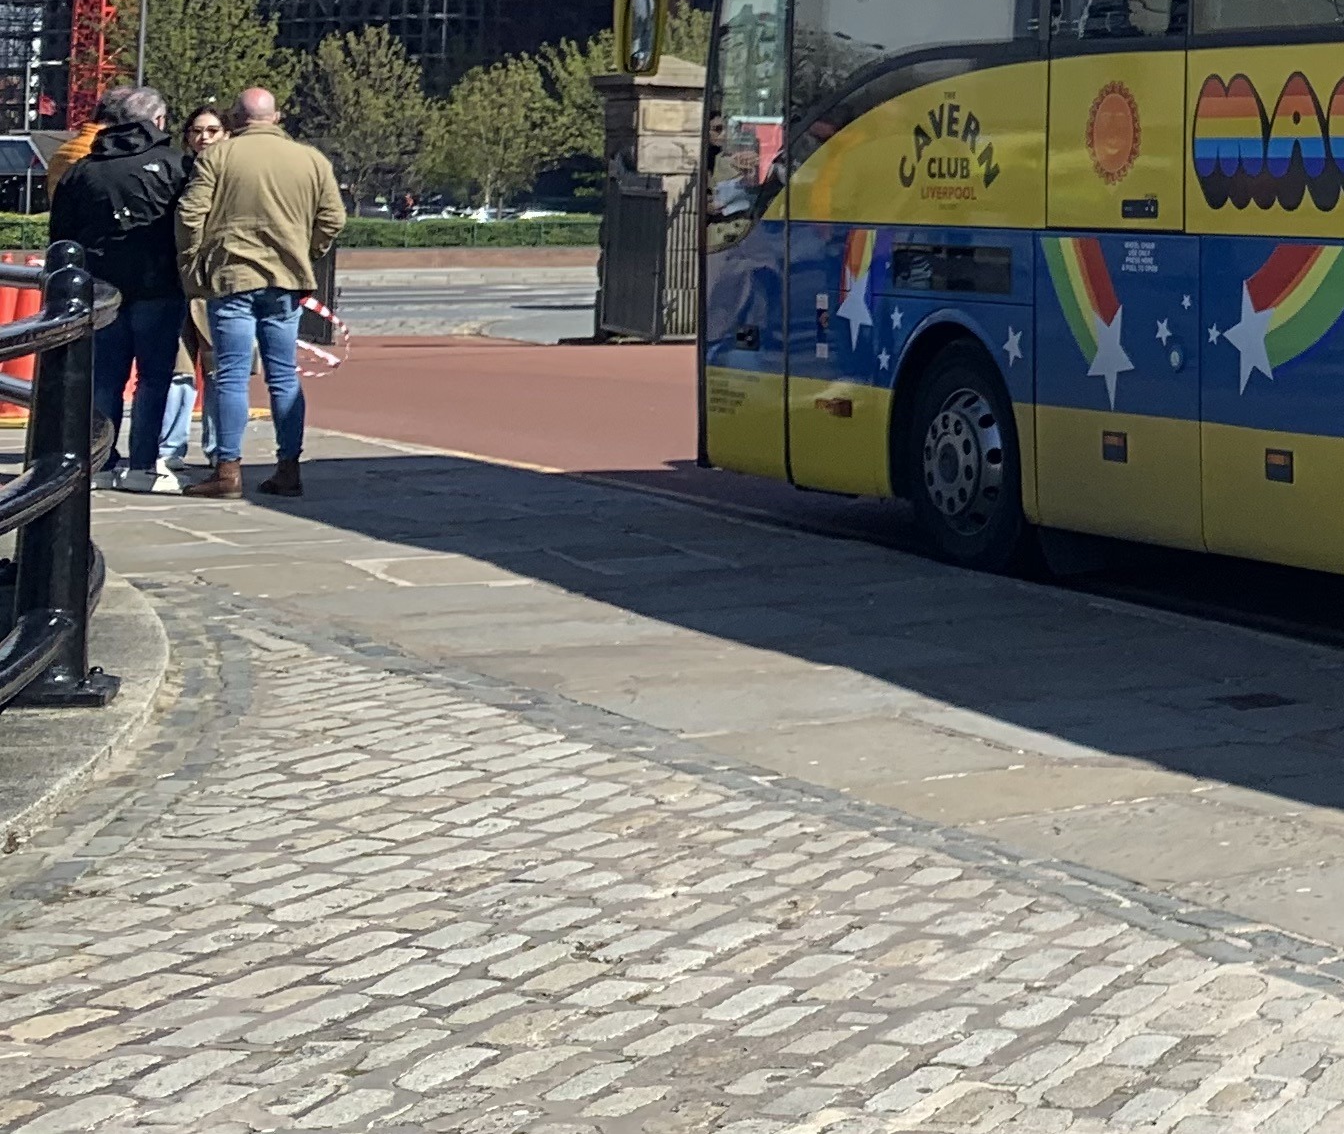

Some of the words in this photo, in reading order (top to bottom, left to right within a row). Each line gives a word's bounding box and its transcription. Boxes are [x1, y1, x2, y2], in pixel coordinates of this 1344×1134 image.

[898, 103, 1001, 189] CAVERN
[927, 157, 970, 179] CLUB
[920, 186, 978, 201] LIVERPOOL
